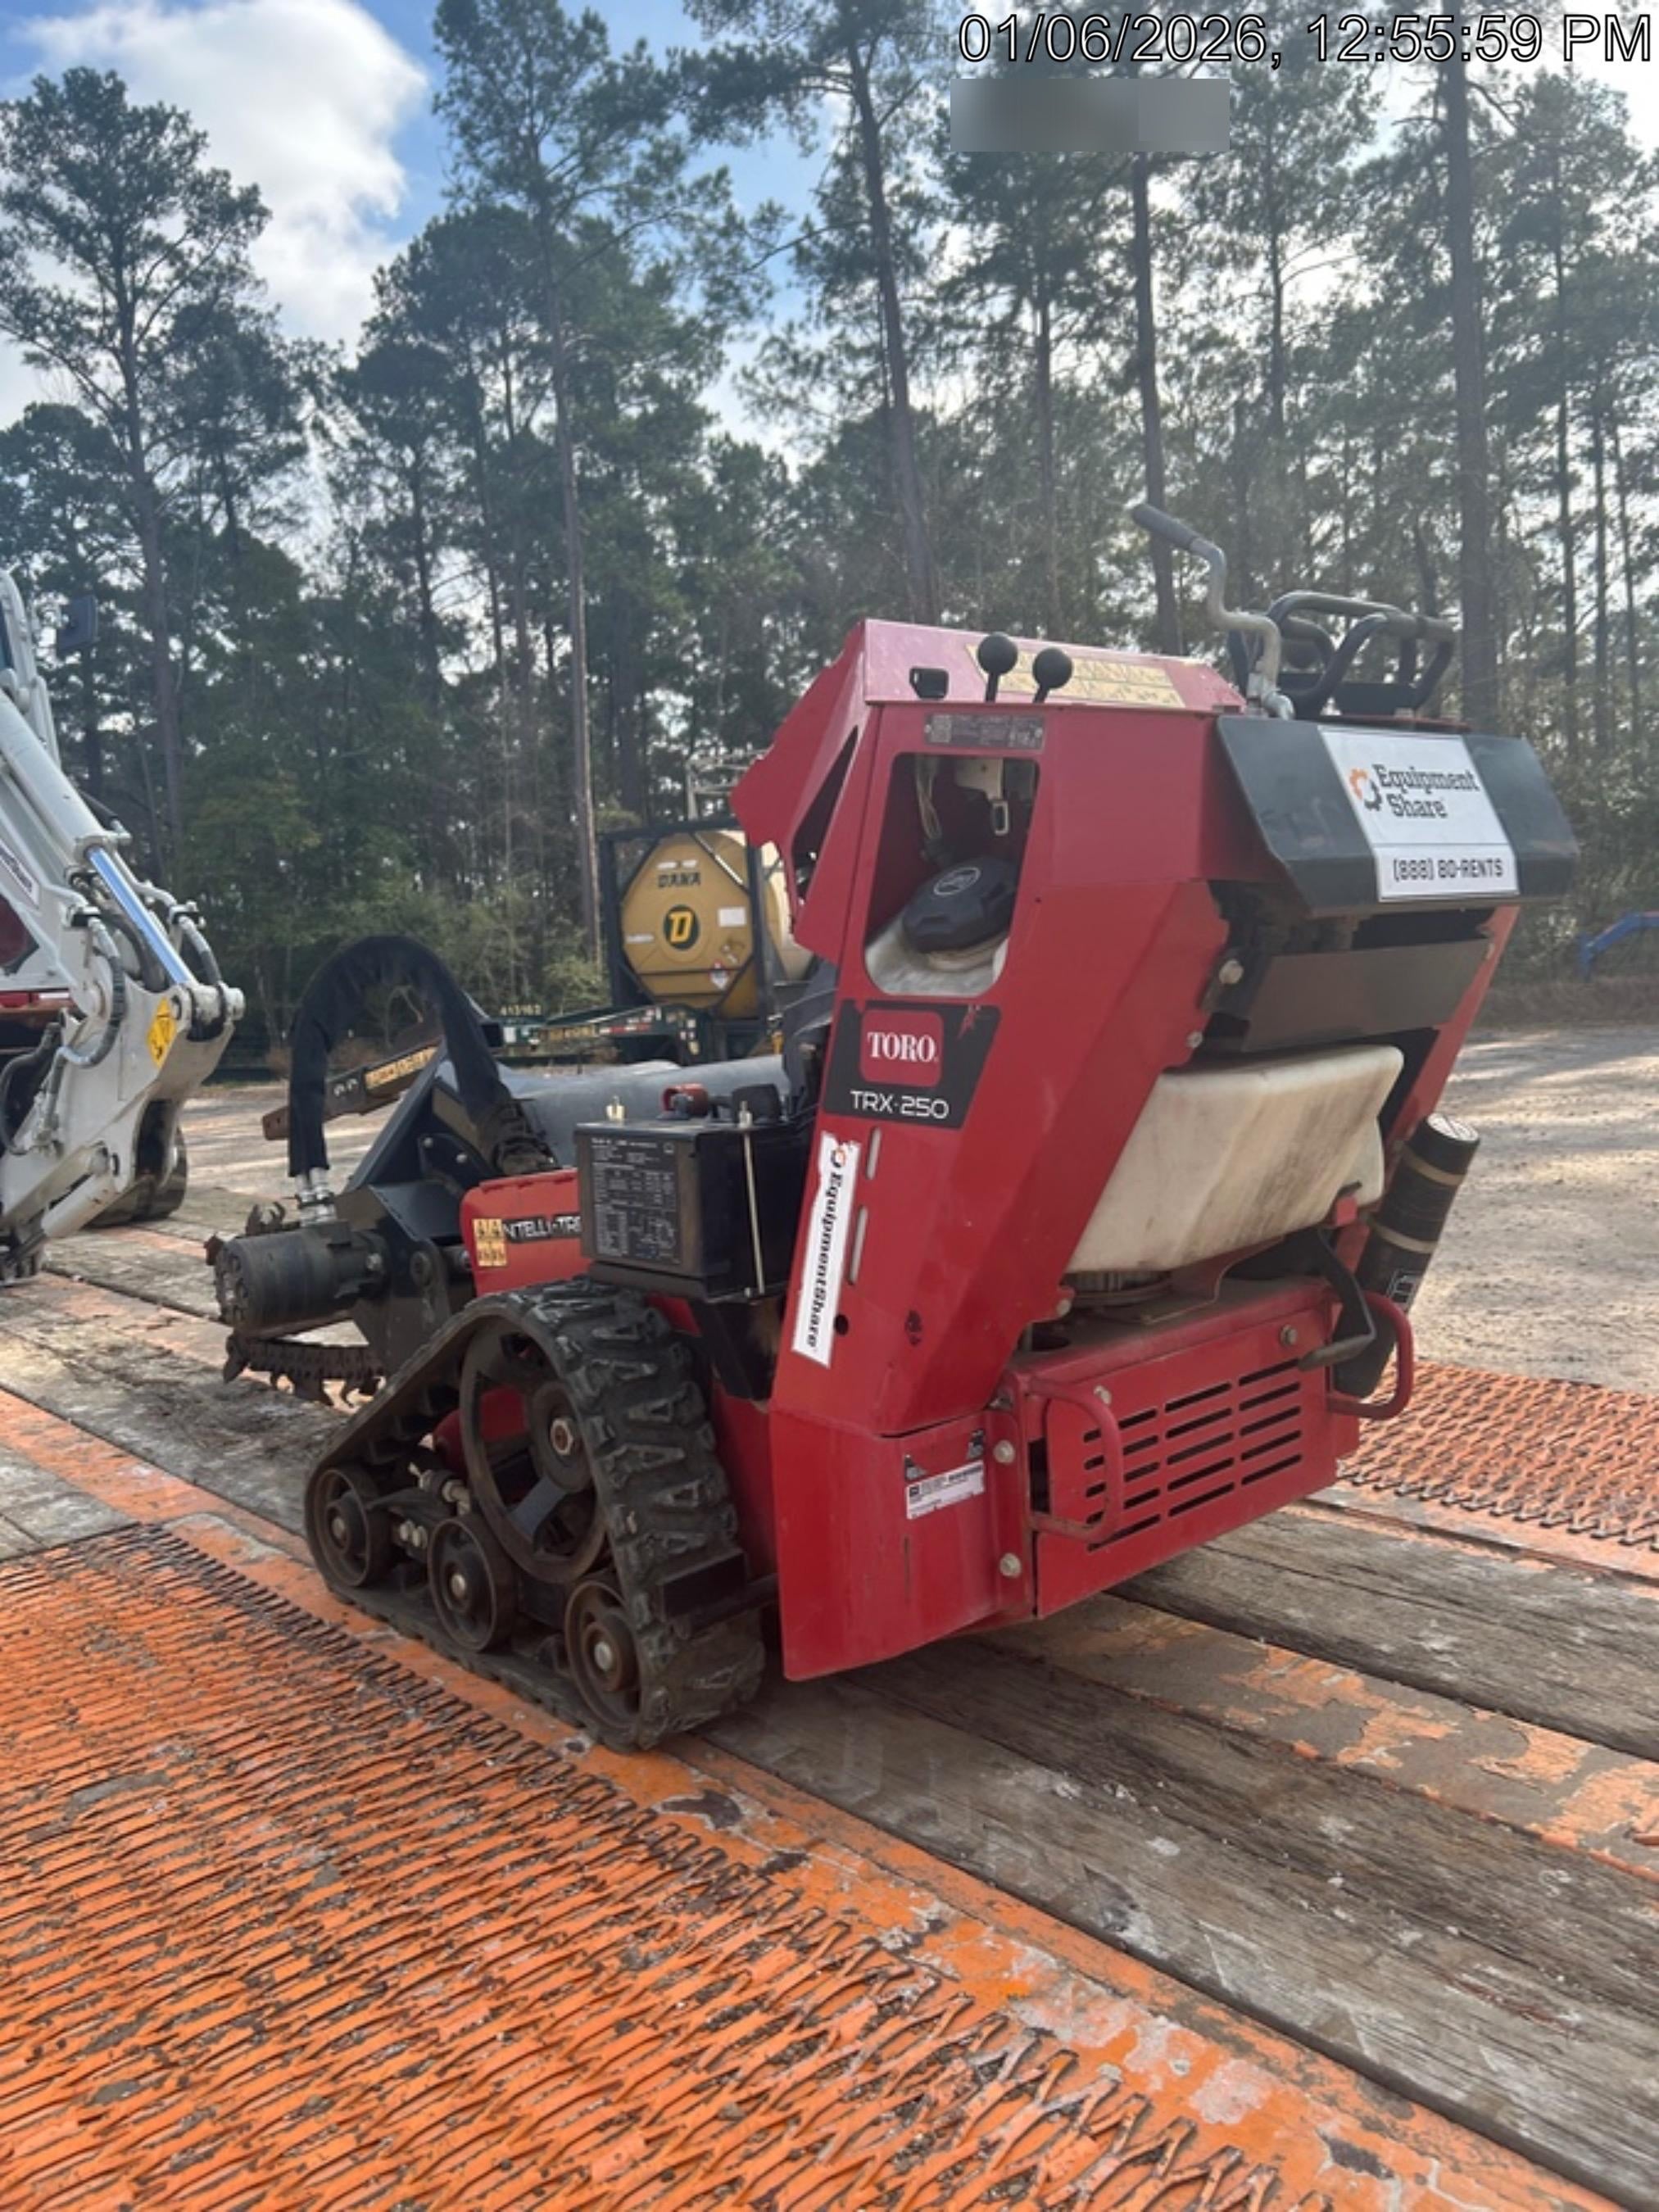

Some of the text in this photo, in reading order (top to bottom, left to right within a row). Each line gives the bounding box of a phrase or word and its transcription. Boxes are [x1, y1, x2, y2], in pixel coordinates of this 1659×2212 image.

[1372, 764, 1480, 794] Equipment
[1386, 795, 1448, 818] Share
[1394, 859, 1503, 882] (888) 80-RENTS
[668, 910, 693, 943] D
[867, 1031, 936, 1063] TORO
[806, 1172, 843, 1348] EquipmentShare
